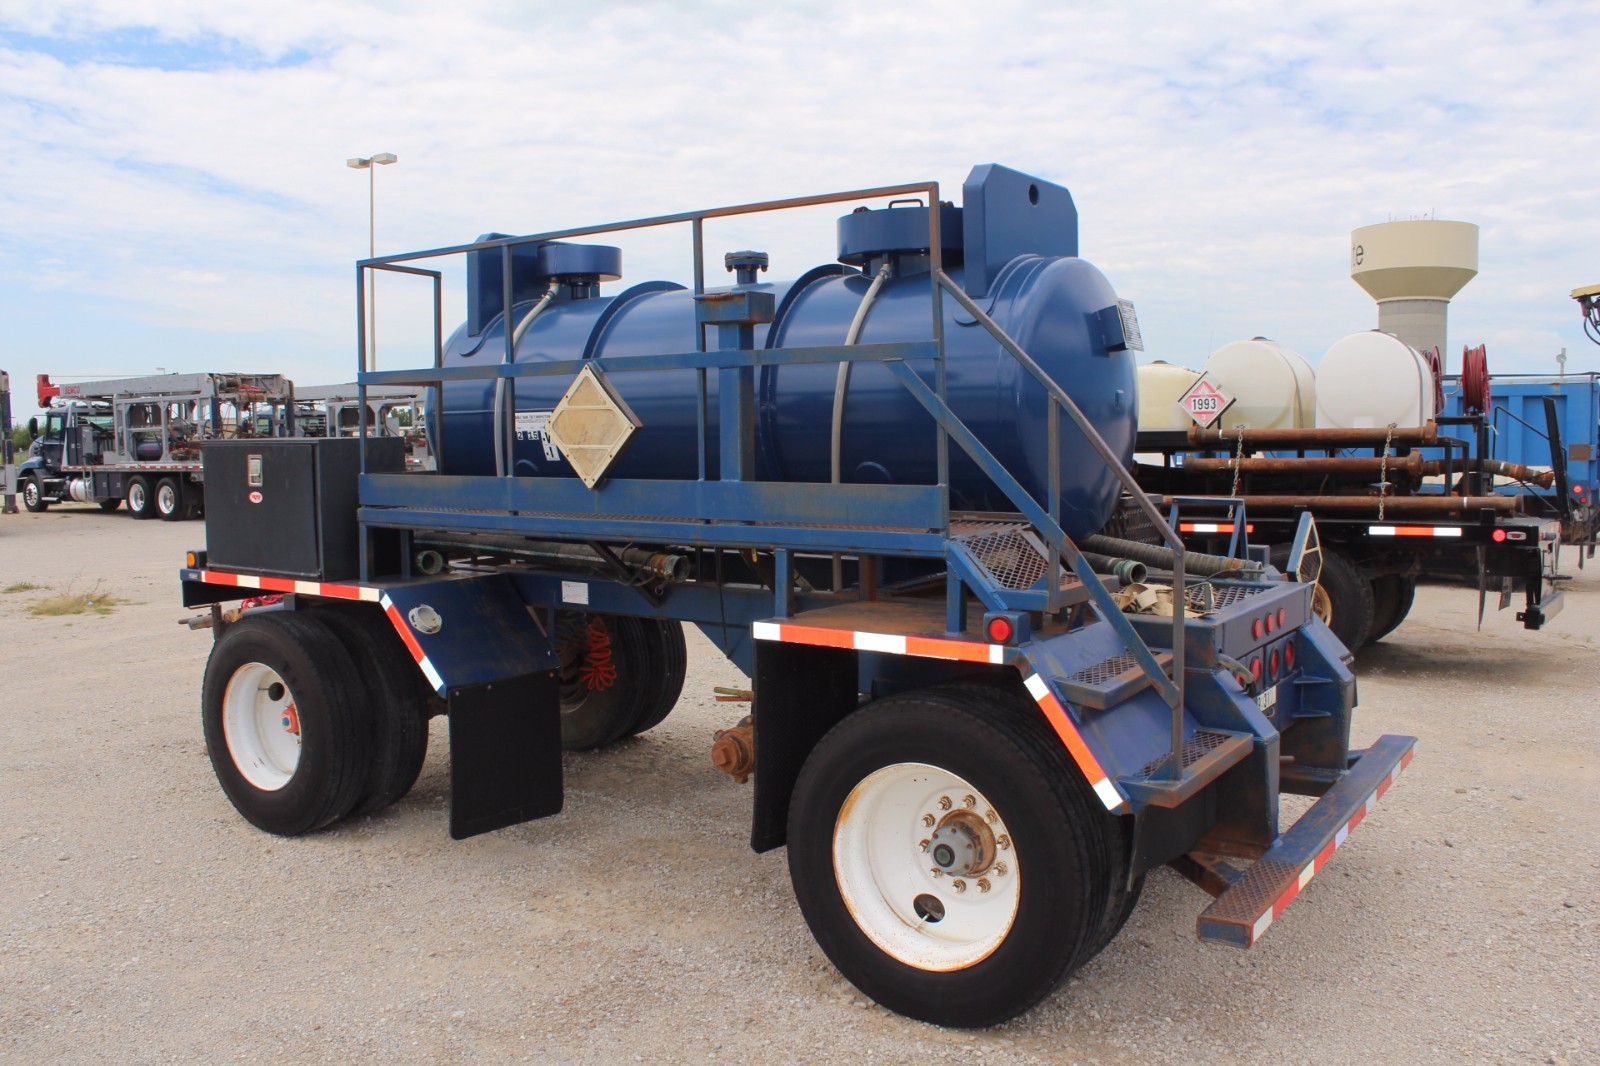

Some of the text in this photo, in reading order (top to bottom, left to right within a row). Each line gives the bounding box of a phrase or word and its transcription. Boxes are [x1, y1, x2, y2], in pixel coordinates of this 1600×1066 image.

[1192, 398, 1216, 410] 1993
[518, 431, 539, 440] 2 15
